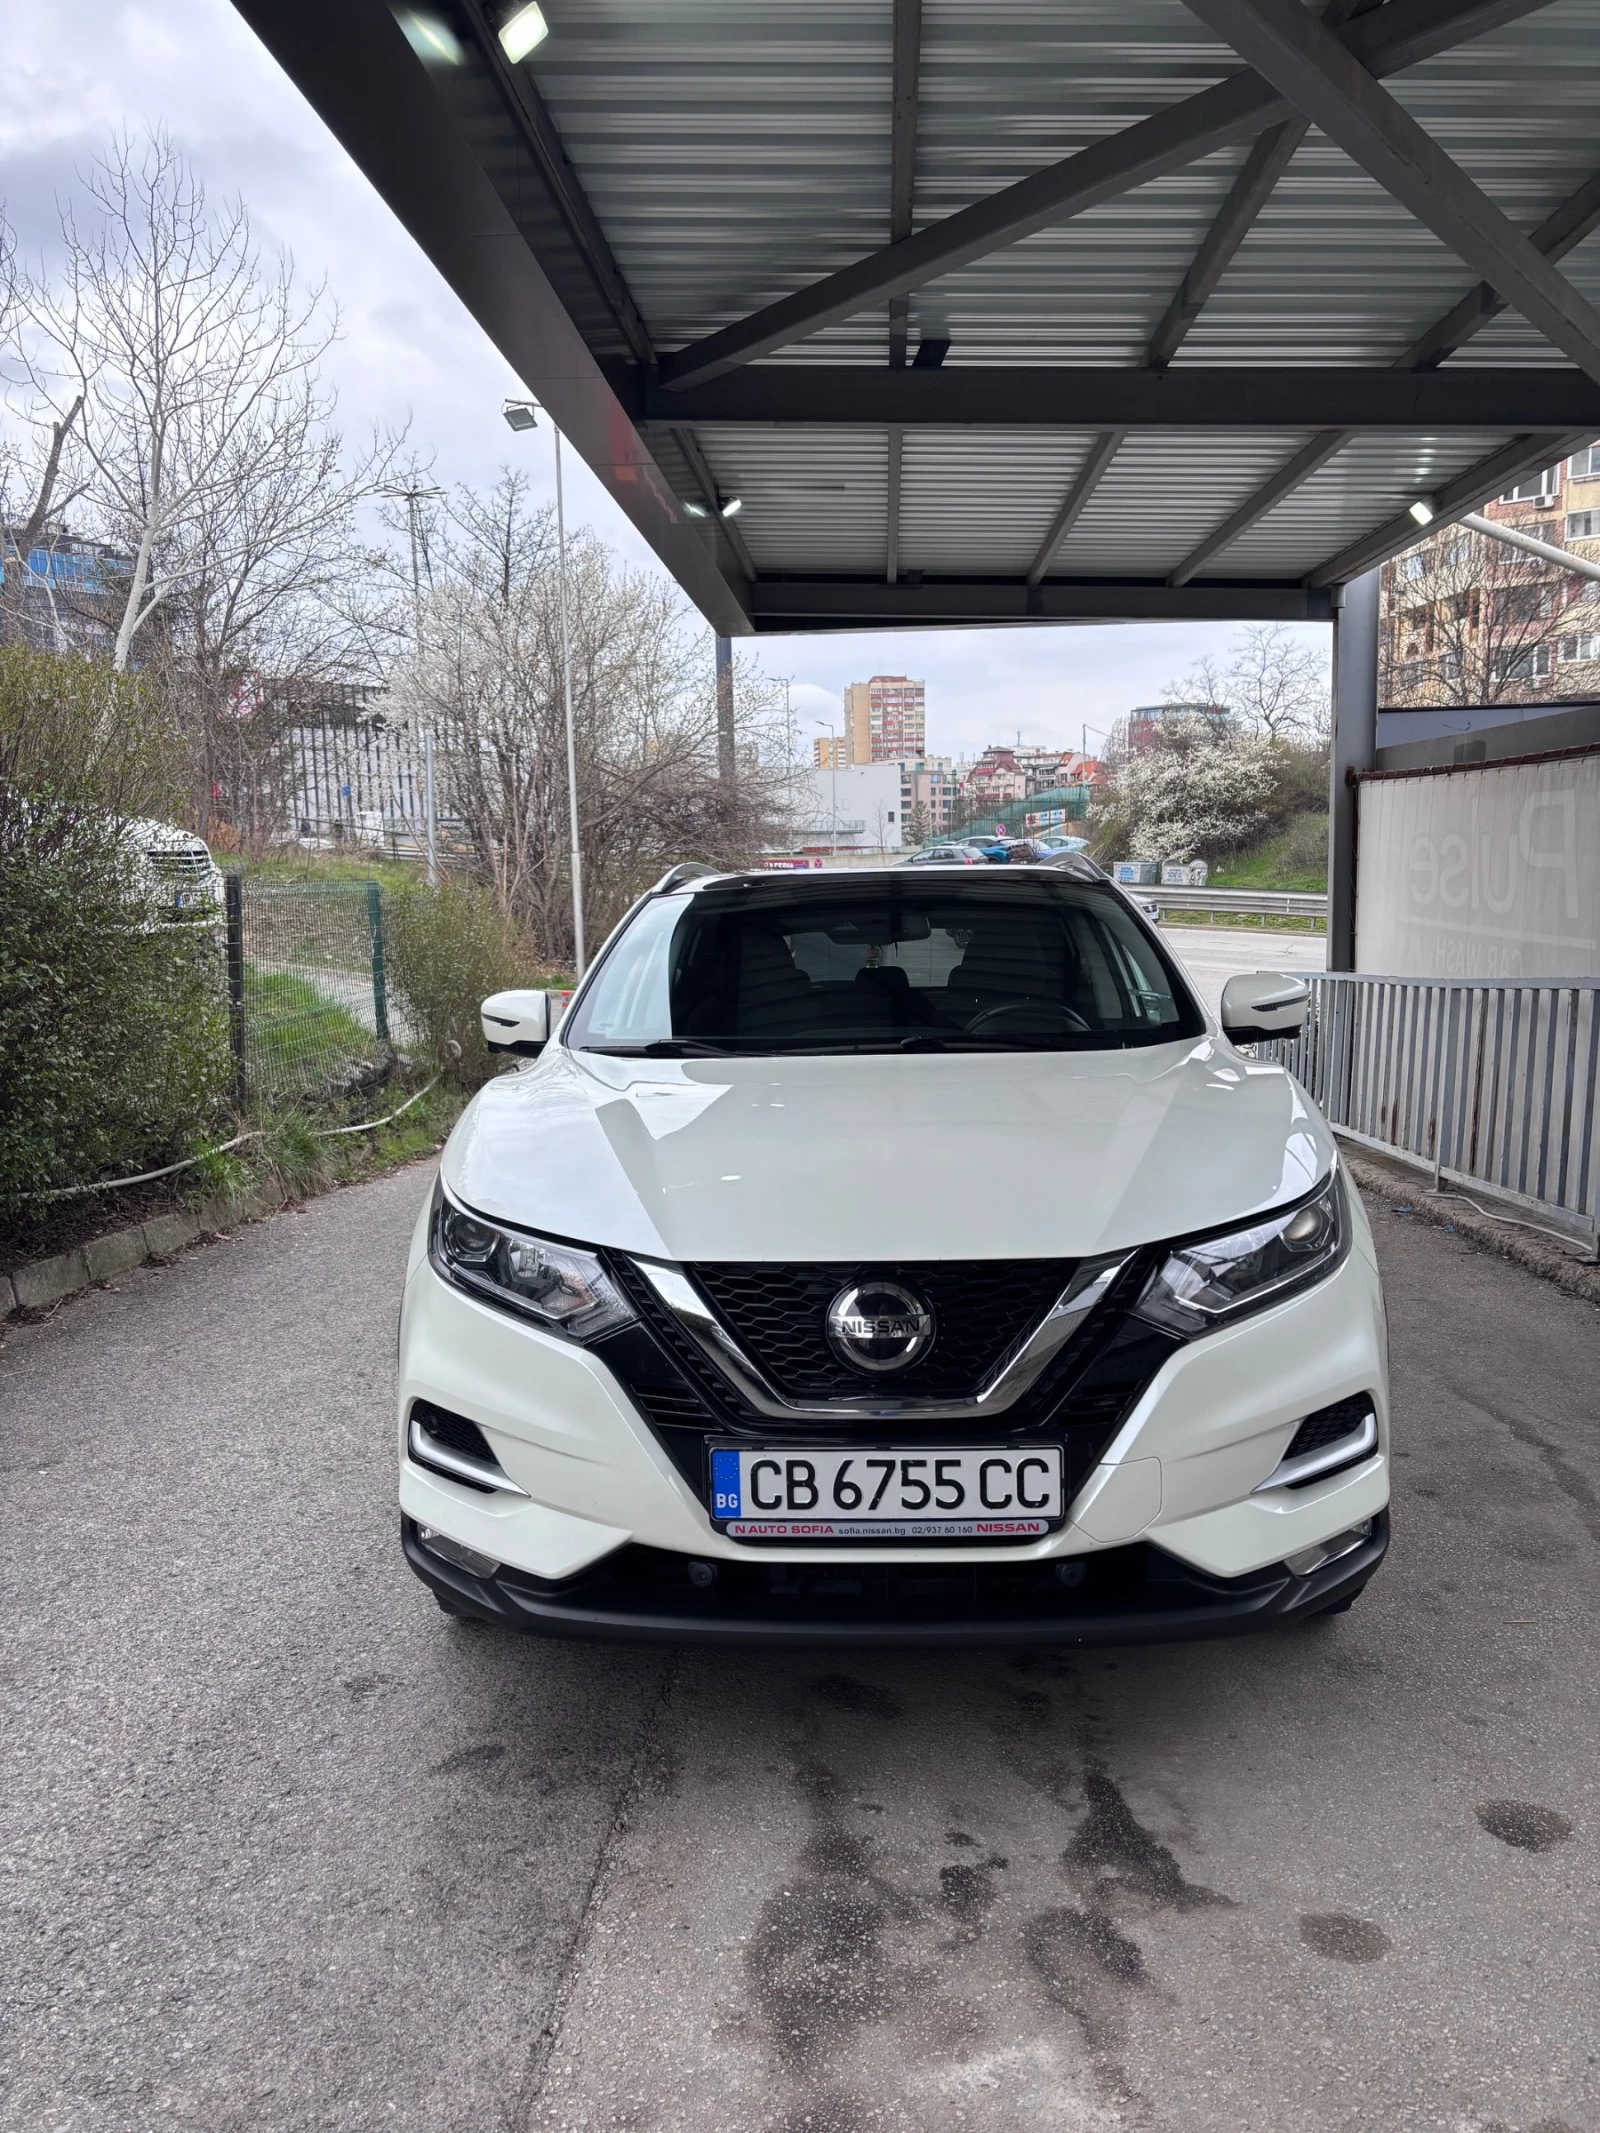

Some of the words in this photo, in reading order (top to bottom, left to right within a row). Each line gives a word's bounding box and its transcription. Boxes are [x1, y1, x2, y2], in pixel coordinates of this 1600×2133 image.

[841, 1319, 920, 1334] NISSAN
[749, 1459, 819, 1511] CB
[832, 1459, 965, 1511] 6755
[978, 1457, 1050, 1510] CC
[716, 1493, 739, 1508] BG
[734, 1524, 748, 1534] N
[748, 1524, 788, 1534] AUTO
[790, 1524, 835, 1534] SOFIA
[838, 1525, 906, 1536] sofia.nissan.bg
[911, 1525, 943, 1535] 02/937
[943, 1525, 956, 1535] 60
[957, 1525, 973, 1535] 160
[976, 1523, 1040, 1533] NISSAN
